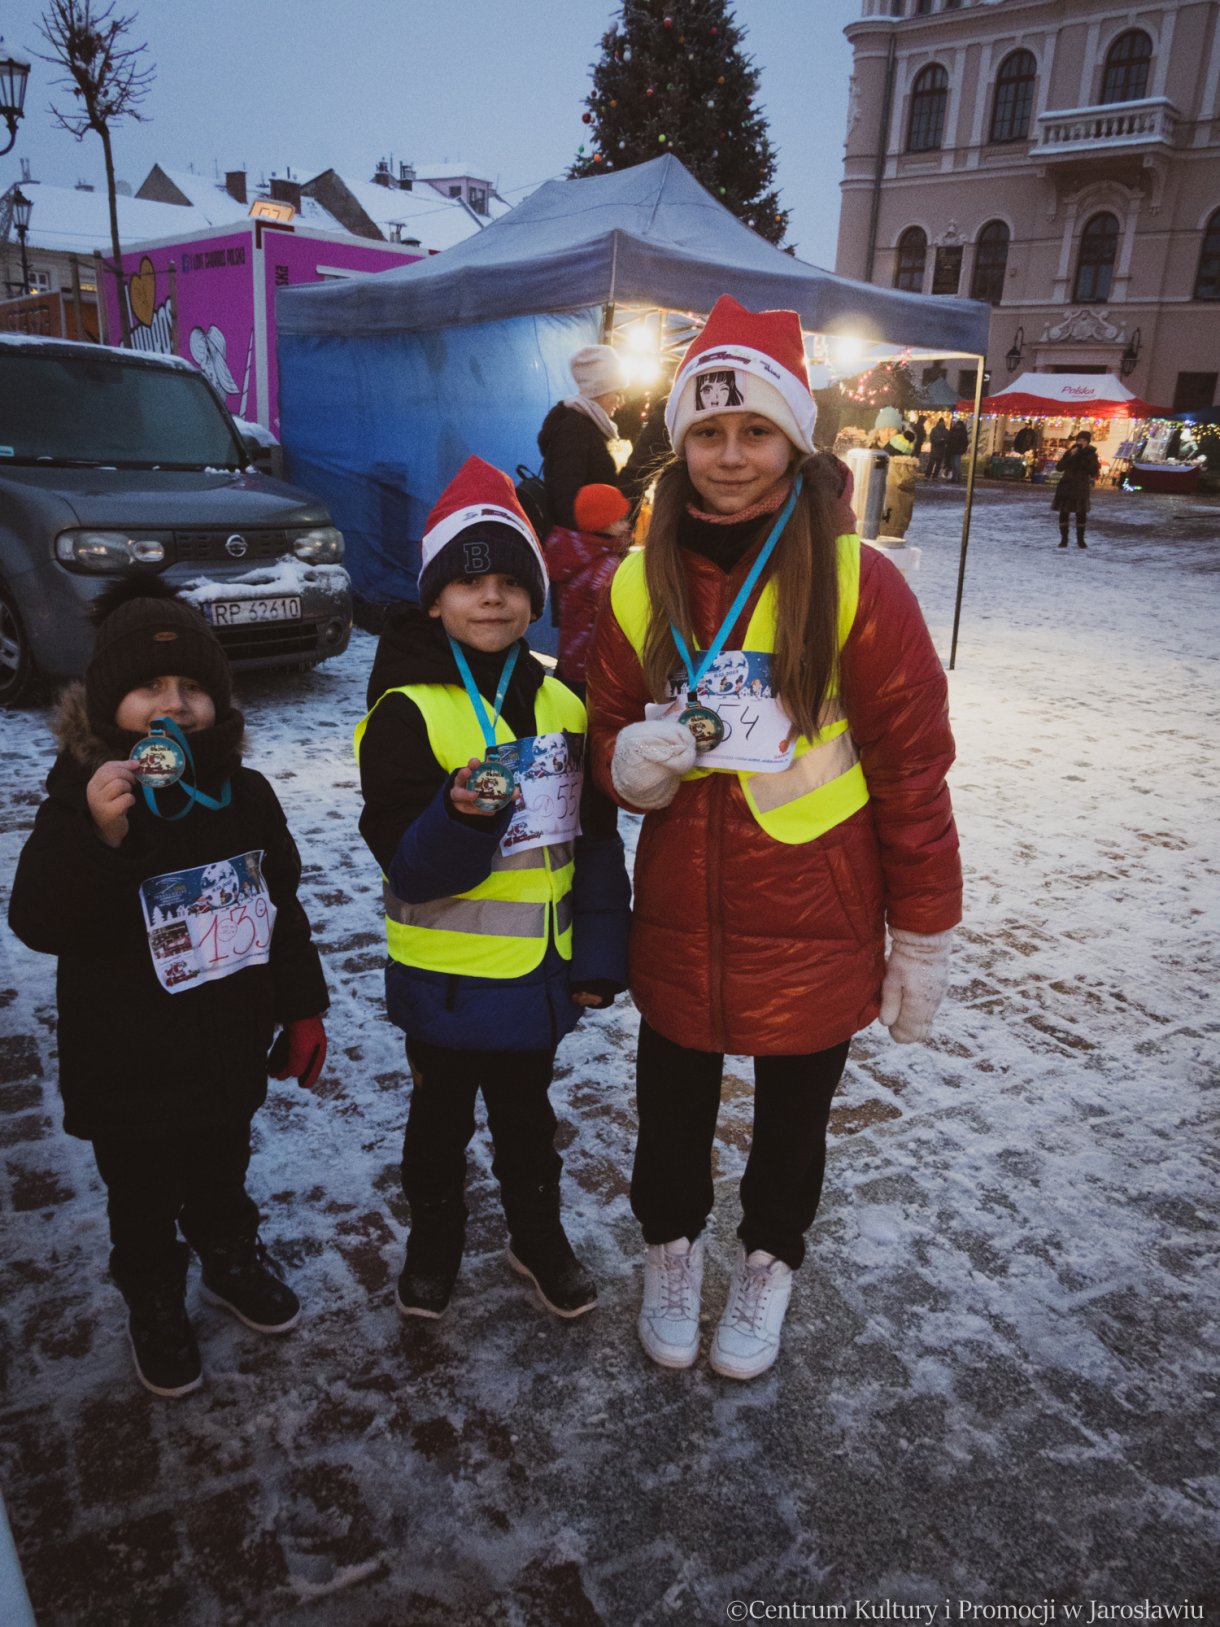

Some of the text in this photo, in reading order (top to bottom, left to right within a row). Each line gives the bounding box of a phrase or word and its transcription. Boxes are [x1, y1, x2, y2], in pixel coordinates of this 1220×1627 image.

[463, 542, 492, 574] B
[214, 598, 299, 625] RP 62610
[198, 897, 273, 964] 139
